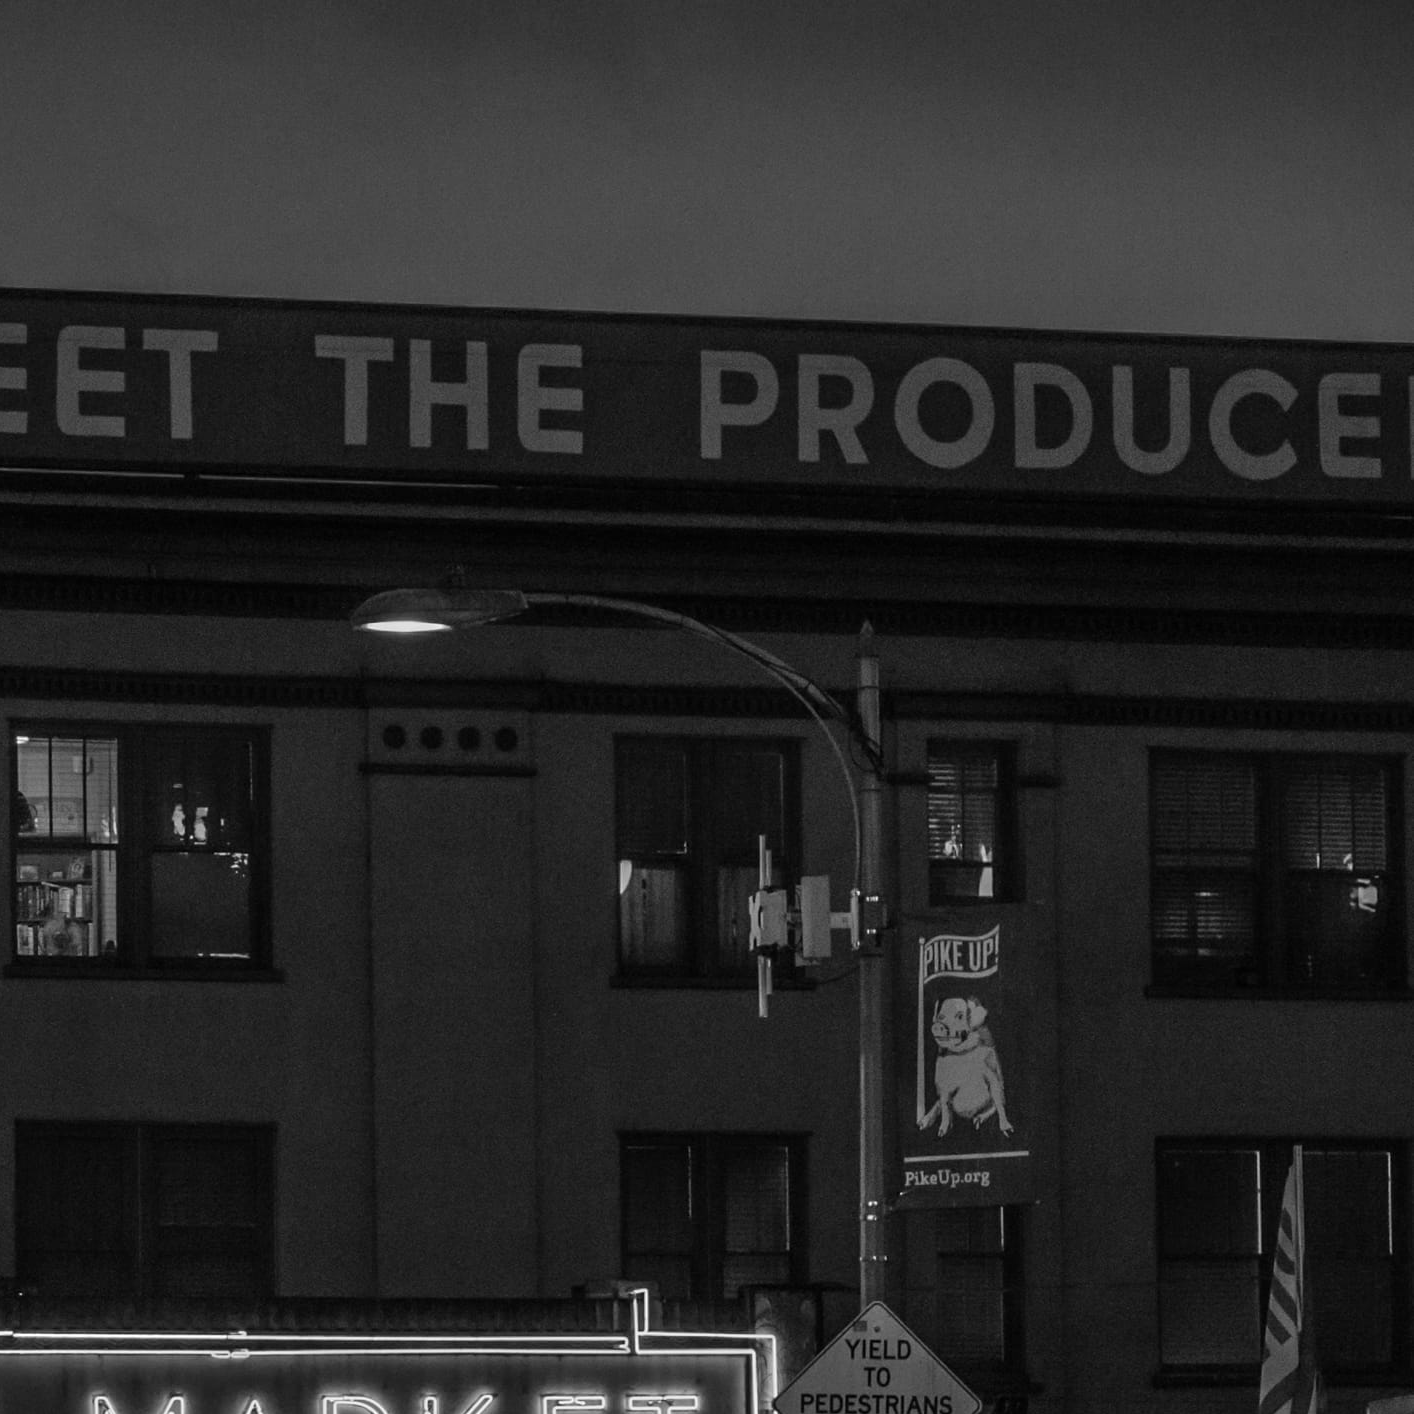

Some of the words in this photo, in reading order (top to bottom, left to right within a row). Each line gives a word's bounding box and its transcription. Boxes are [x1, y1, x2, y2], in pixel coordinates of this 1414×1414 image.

[314, 333, 586, 456] THE
[698, 347, 1414, 482] PRODUCE
[924, 940, 964, 978] PIKE
[968, 933, 999, 971] UP!
[904, 1169, 990, 1188] PikeUp.org
[845, 1339, 912, 1360] YIELD
[864, 1367, 891, 1388] TO
